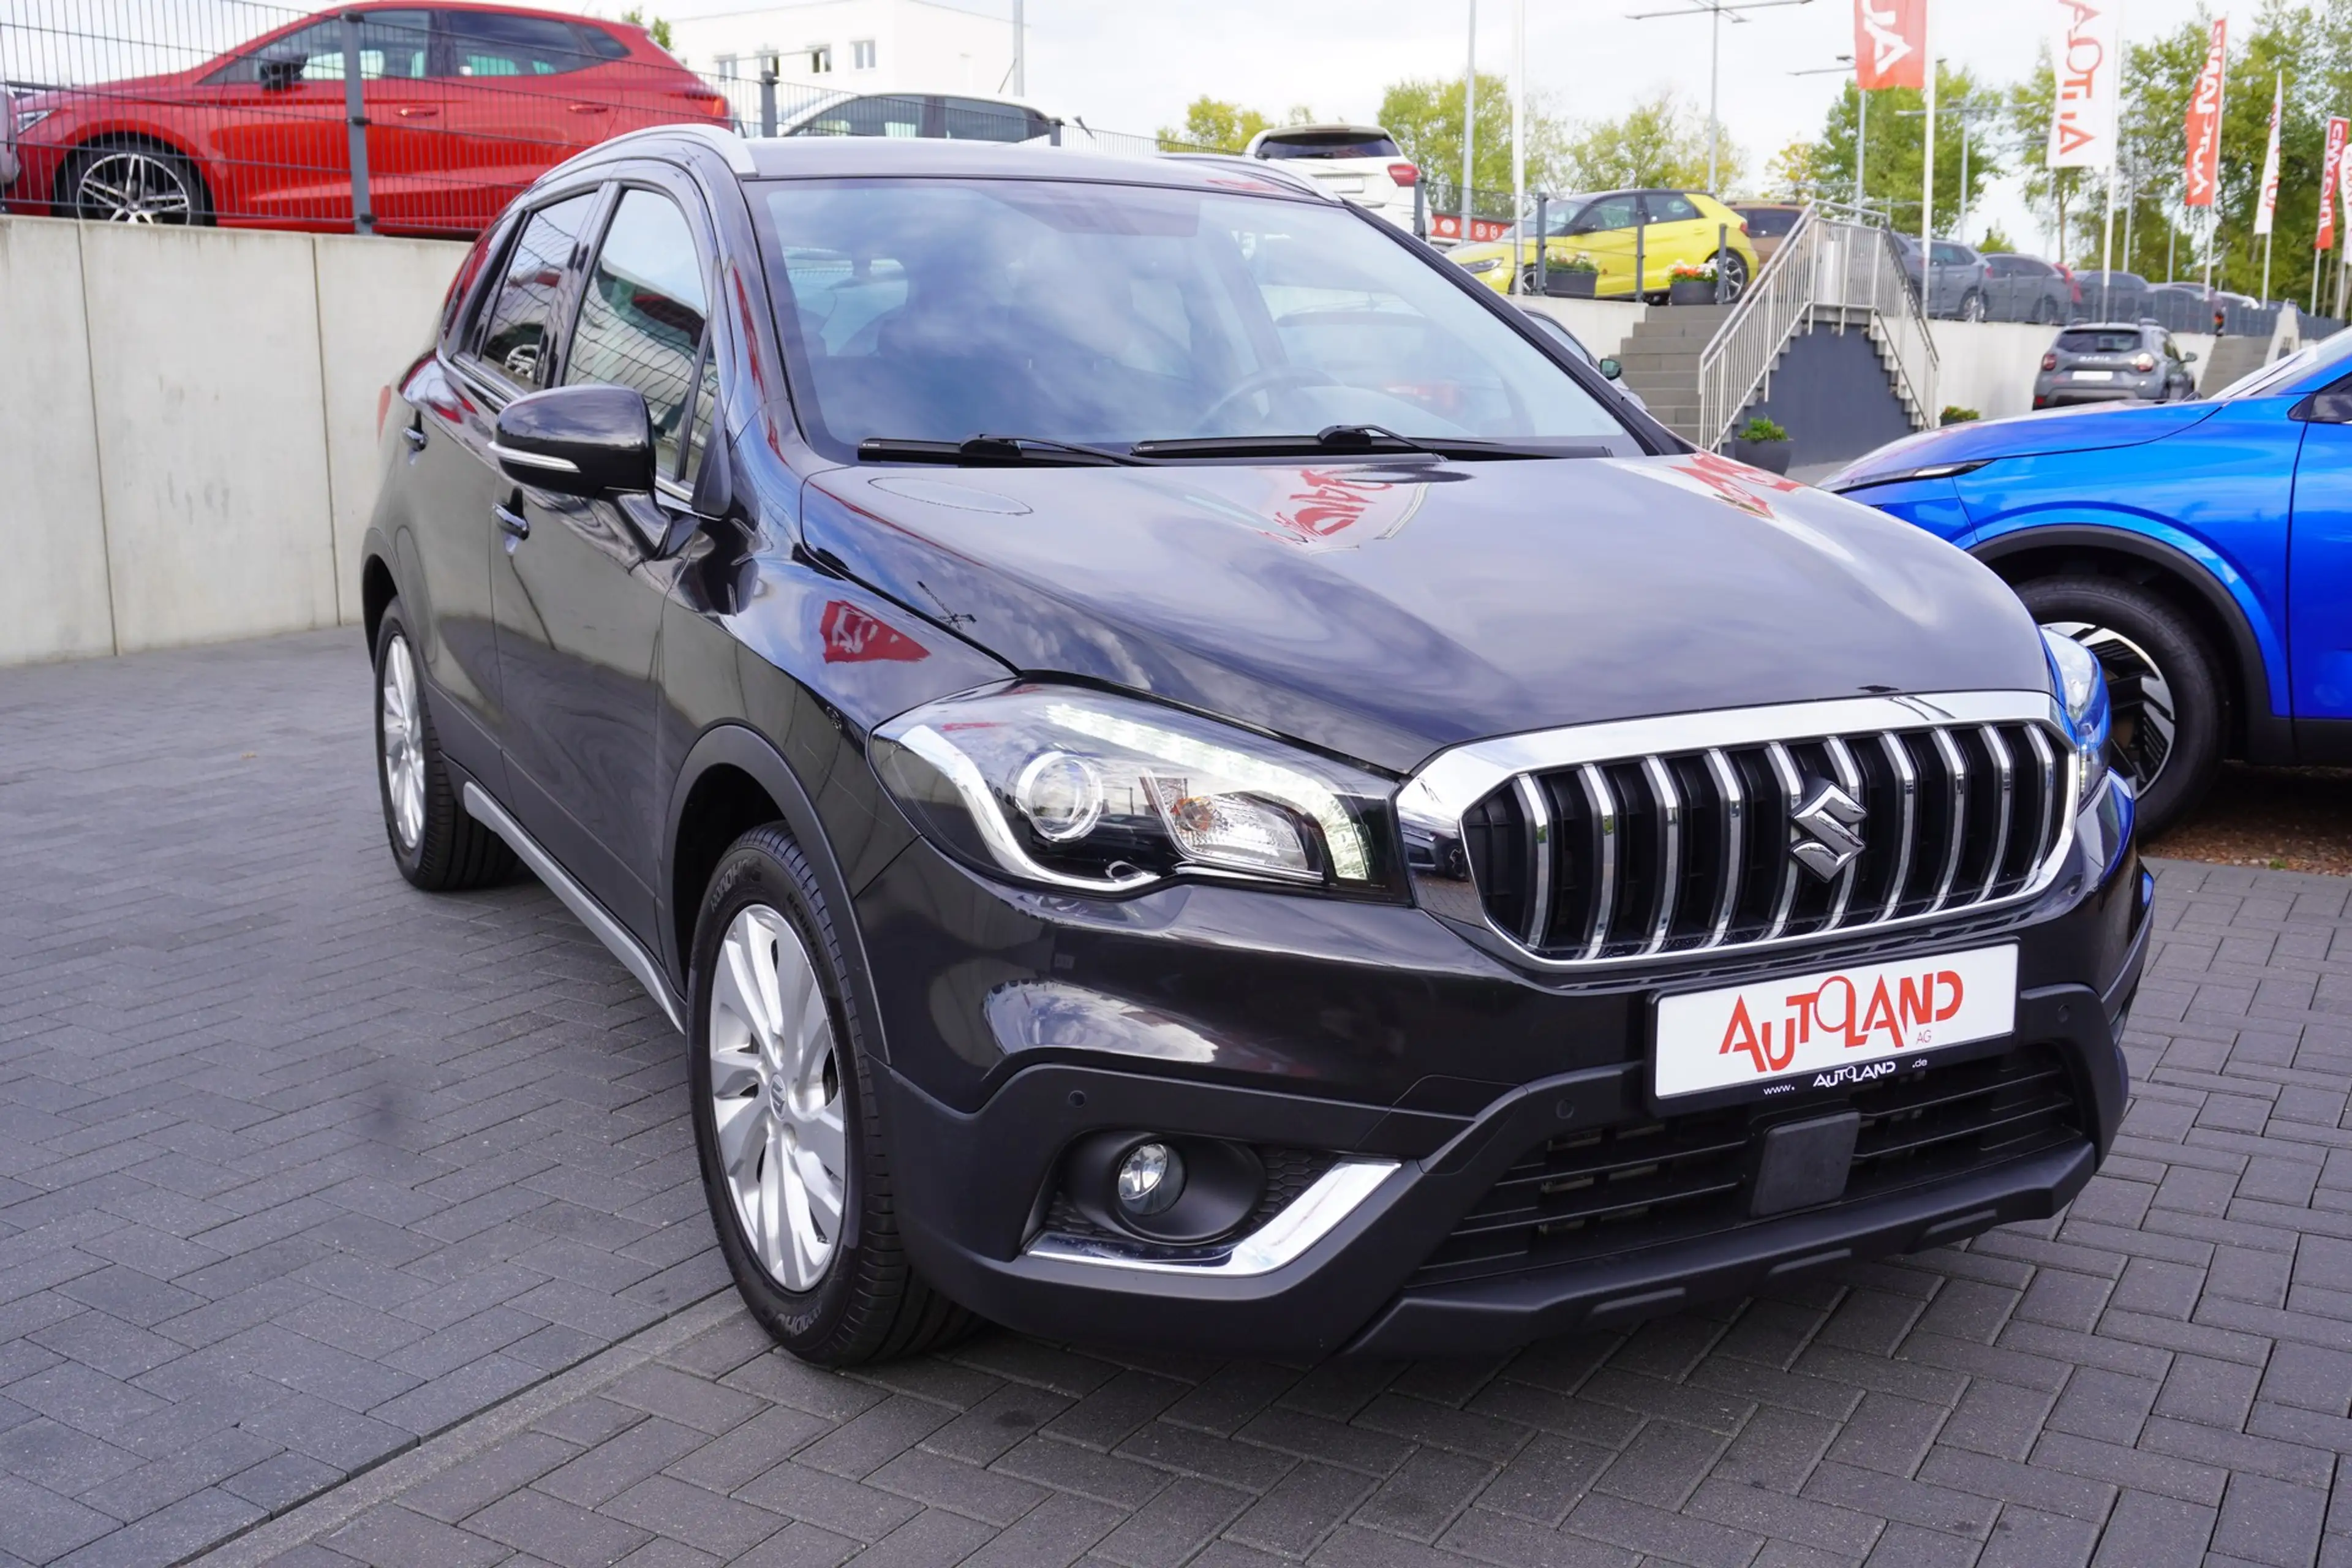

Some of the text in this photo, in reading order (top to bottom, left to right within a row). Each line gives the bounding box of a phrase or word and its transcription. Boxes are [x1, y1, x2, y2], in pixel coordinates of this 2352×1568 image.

[1719, 970, 1964, 1073] AUTOLAND
[1915, 1029, 1932, 1046] AG
[1763, 1058, 1928, 1095] www. AUTOLAND .de
